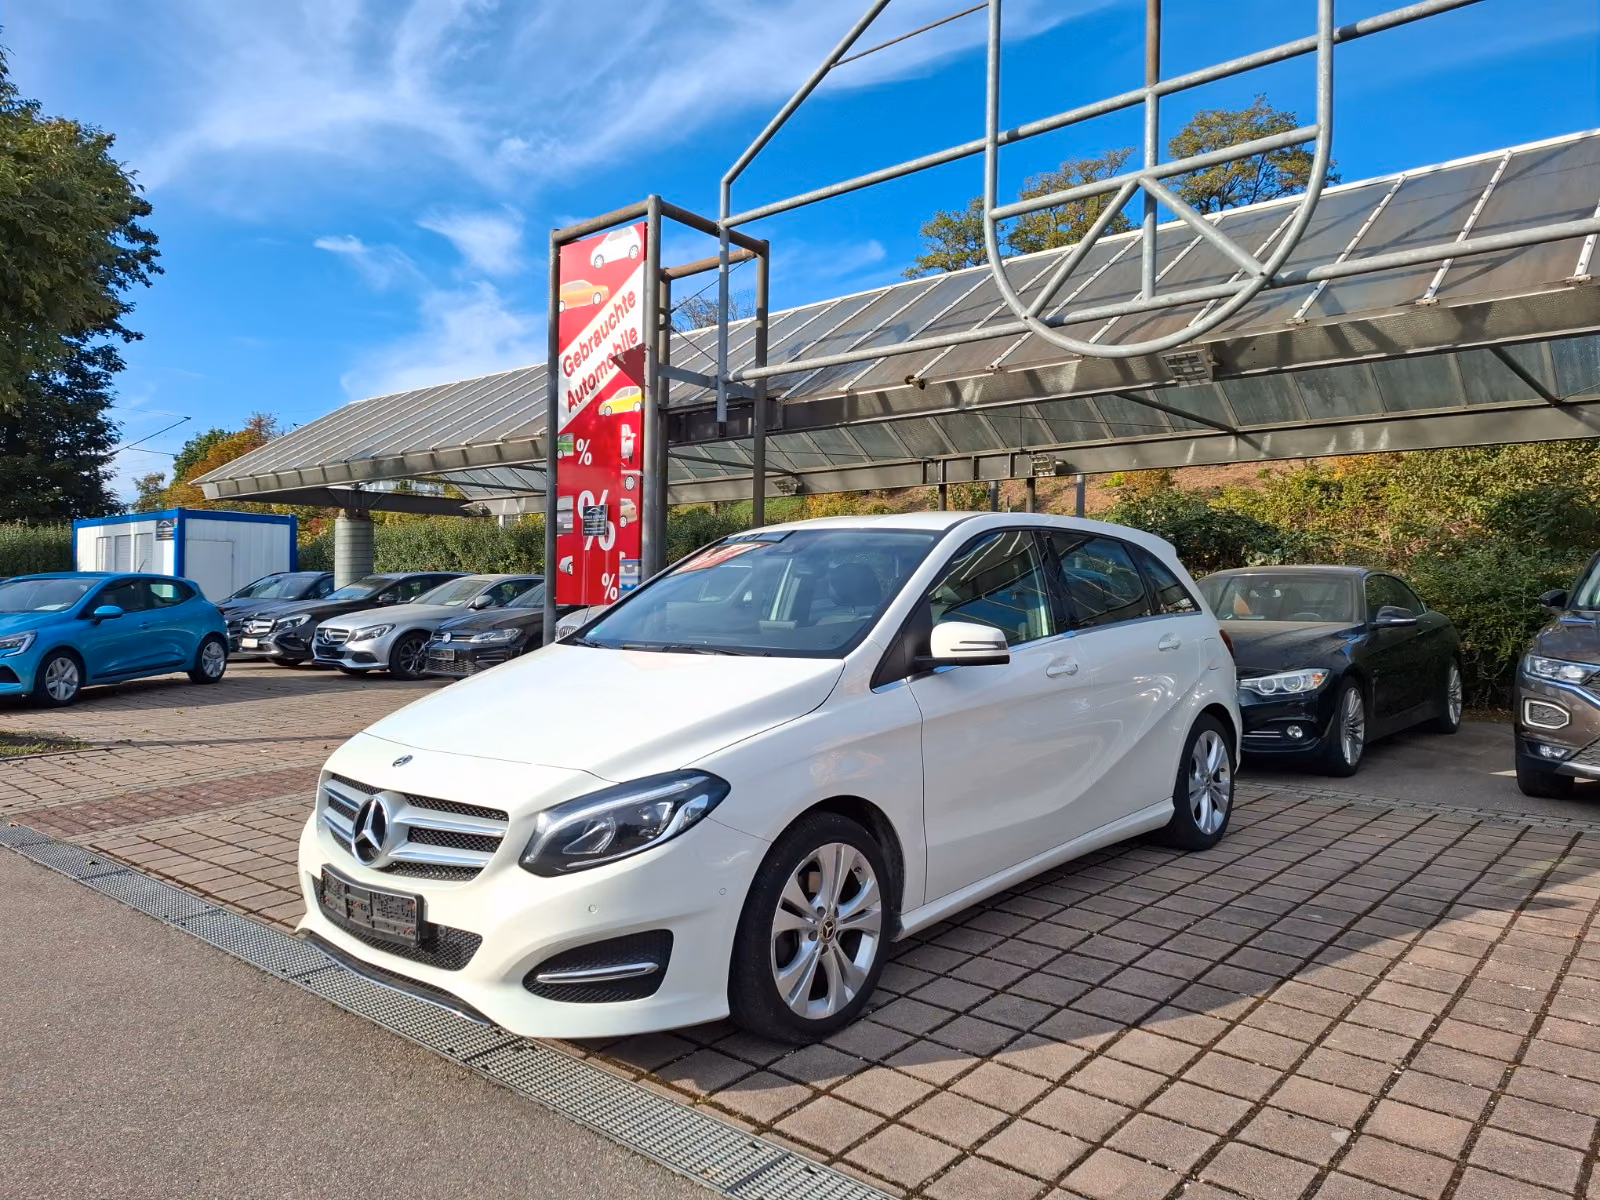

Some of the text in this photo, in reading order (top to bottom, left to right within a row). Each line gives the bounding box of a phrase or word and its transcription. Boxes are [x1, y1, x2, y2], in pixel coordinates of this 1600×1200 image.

[563, 291, 636, 377] Gebrauchte
[567, 327, 638, 413] Automobile
[576, 438, 593, 465] %
[601, 572, 618, 600] %
